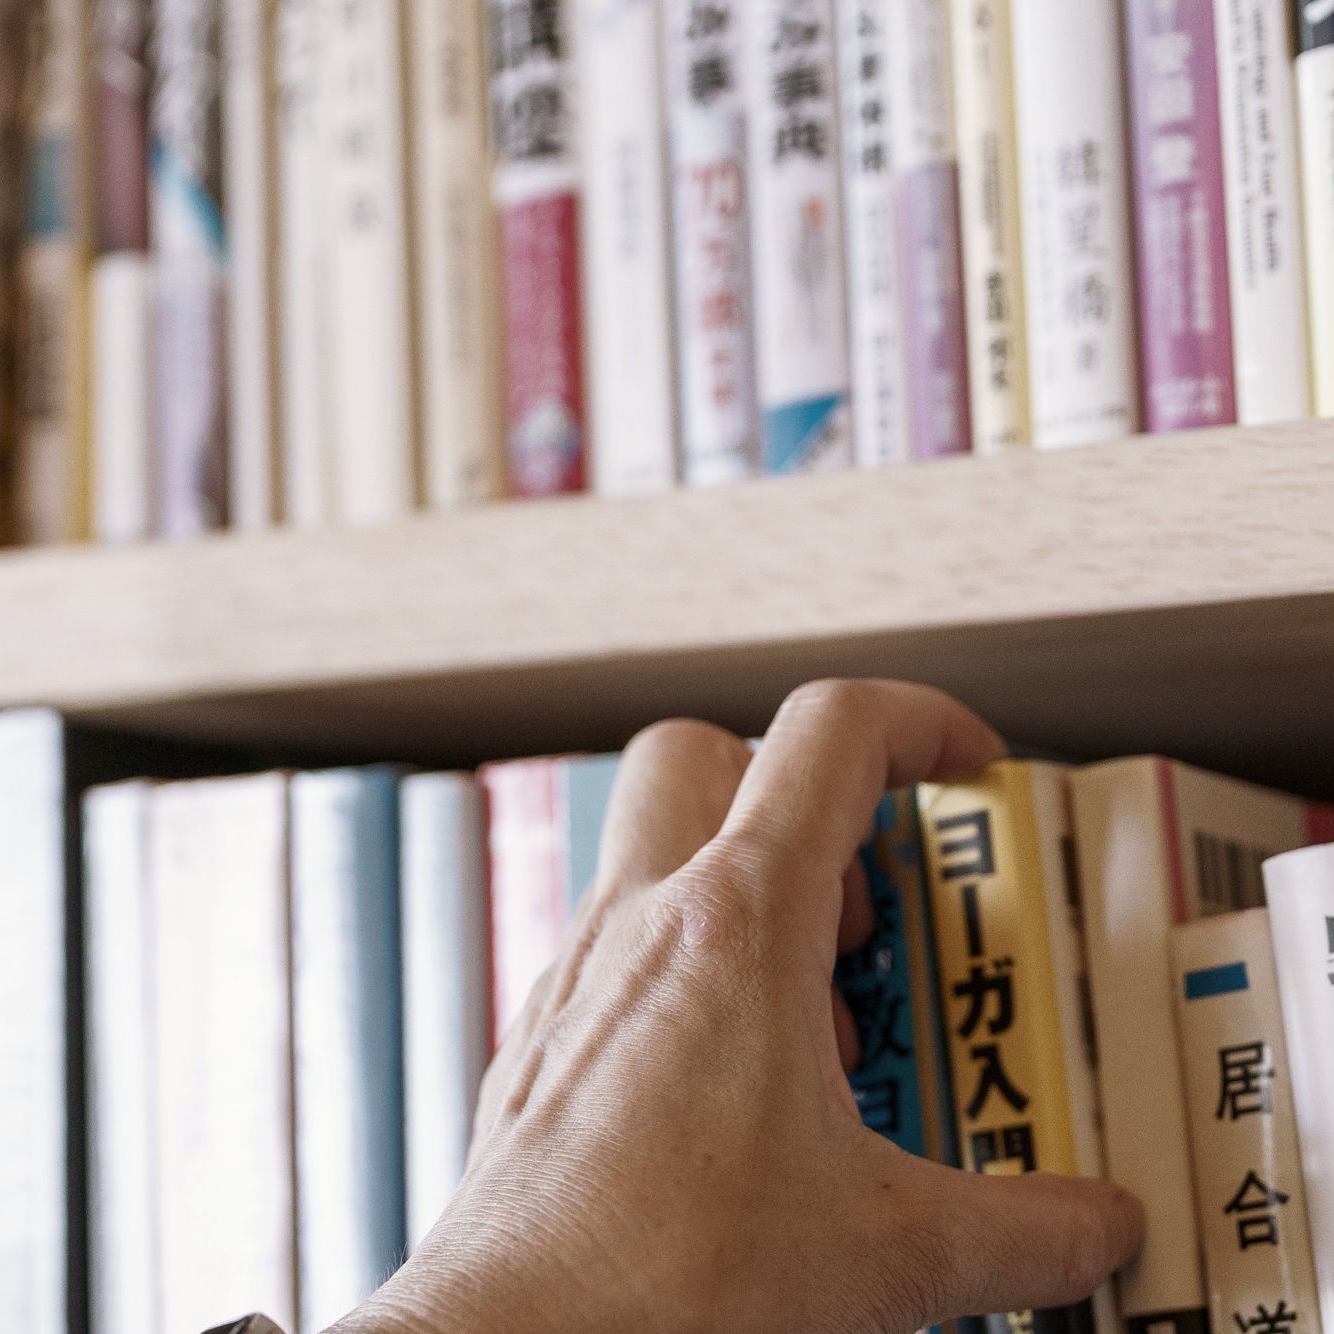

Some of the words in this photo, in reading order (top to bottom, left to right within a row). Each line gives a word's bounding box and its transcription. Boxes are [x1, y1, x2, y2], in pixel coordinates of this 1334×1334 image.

[936, 808, 1038, 1175] ヨーガ入門
